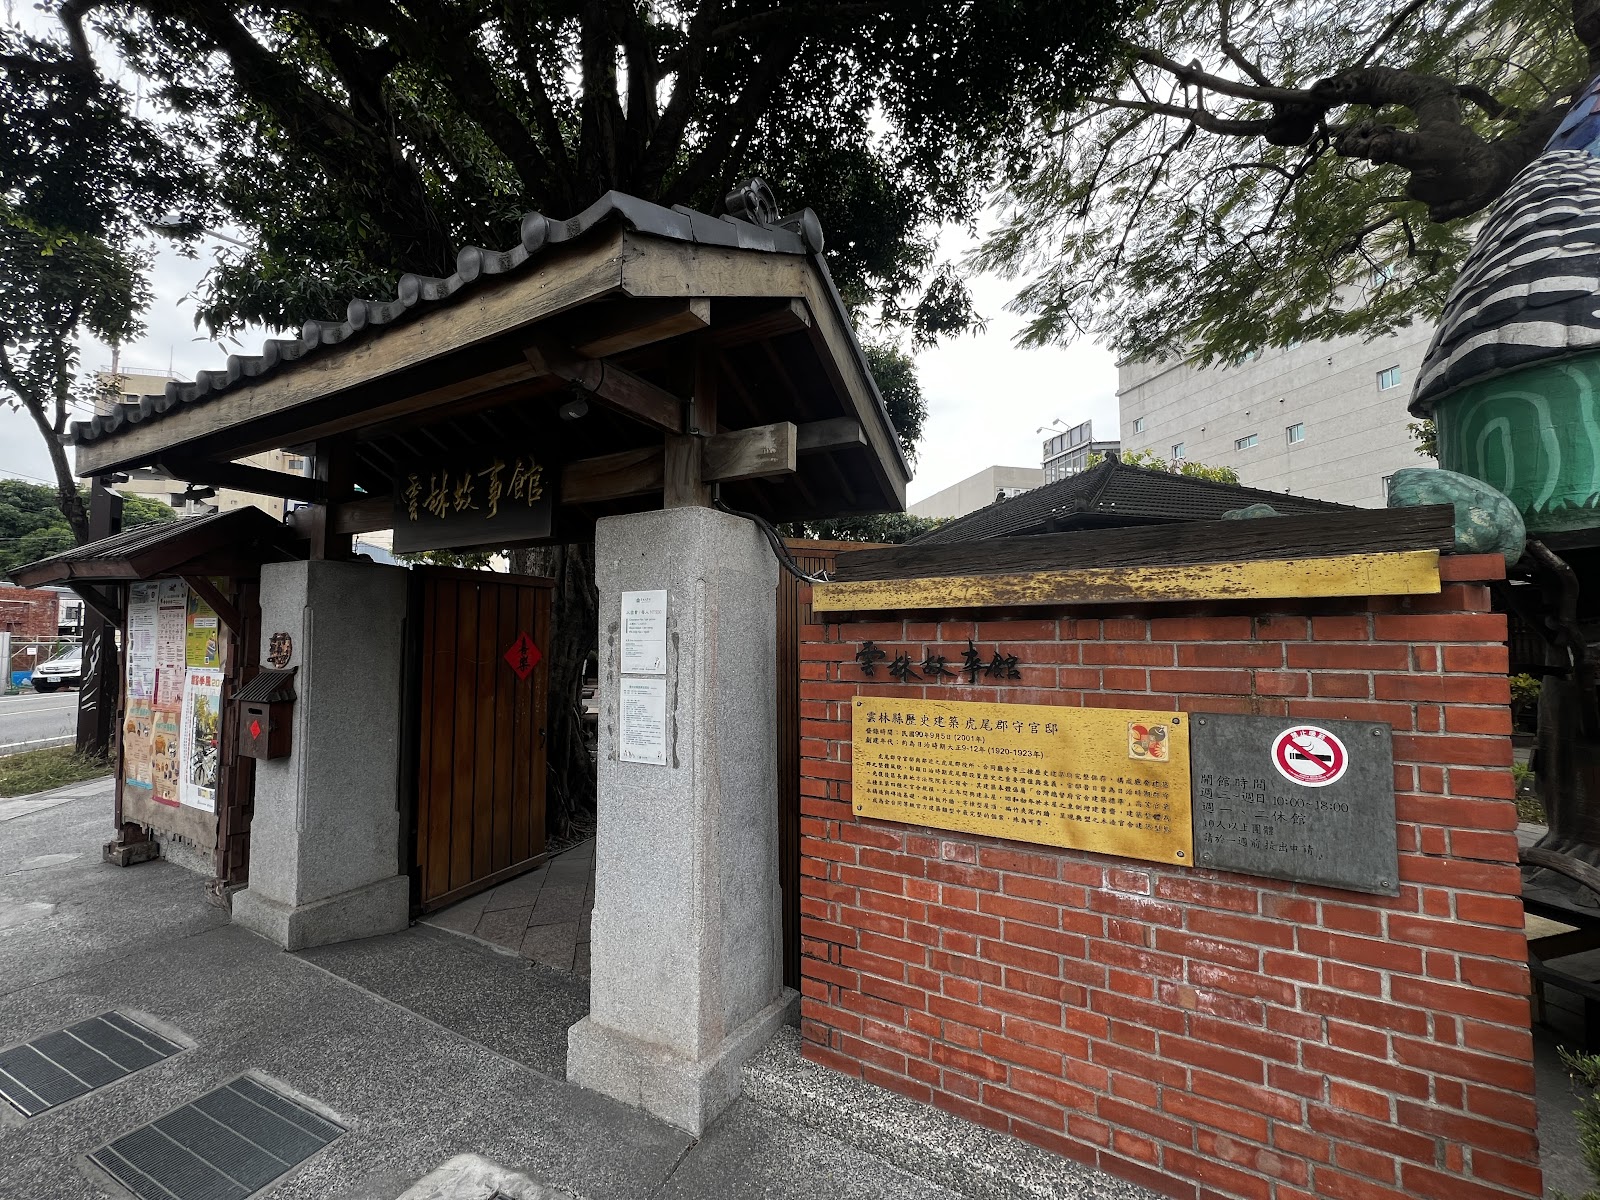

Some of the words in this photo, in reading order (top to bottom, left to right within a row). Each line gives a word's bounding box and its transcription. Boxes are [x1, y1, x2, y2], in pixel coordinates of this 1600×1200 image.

[855, 637, 1021, 683] 雲林故事館
[1200, 774, 1266, 791] 開館時間
